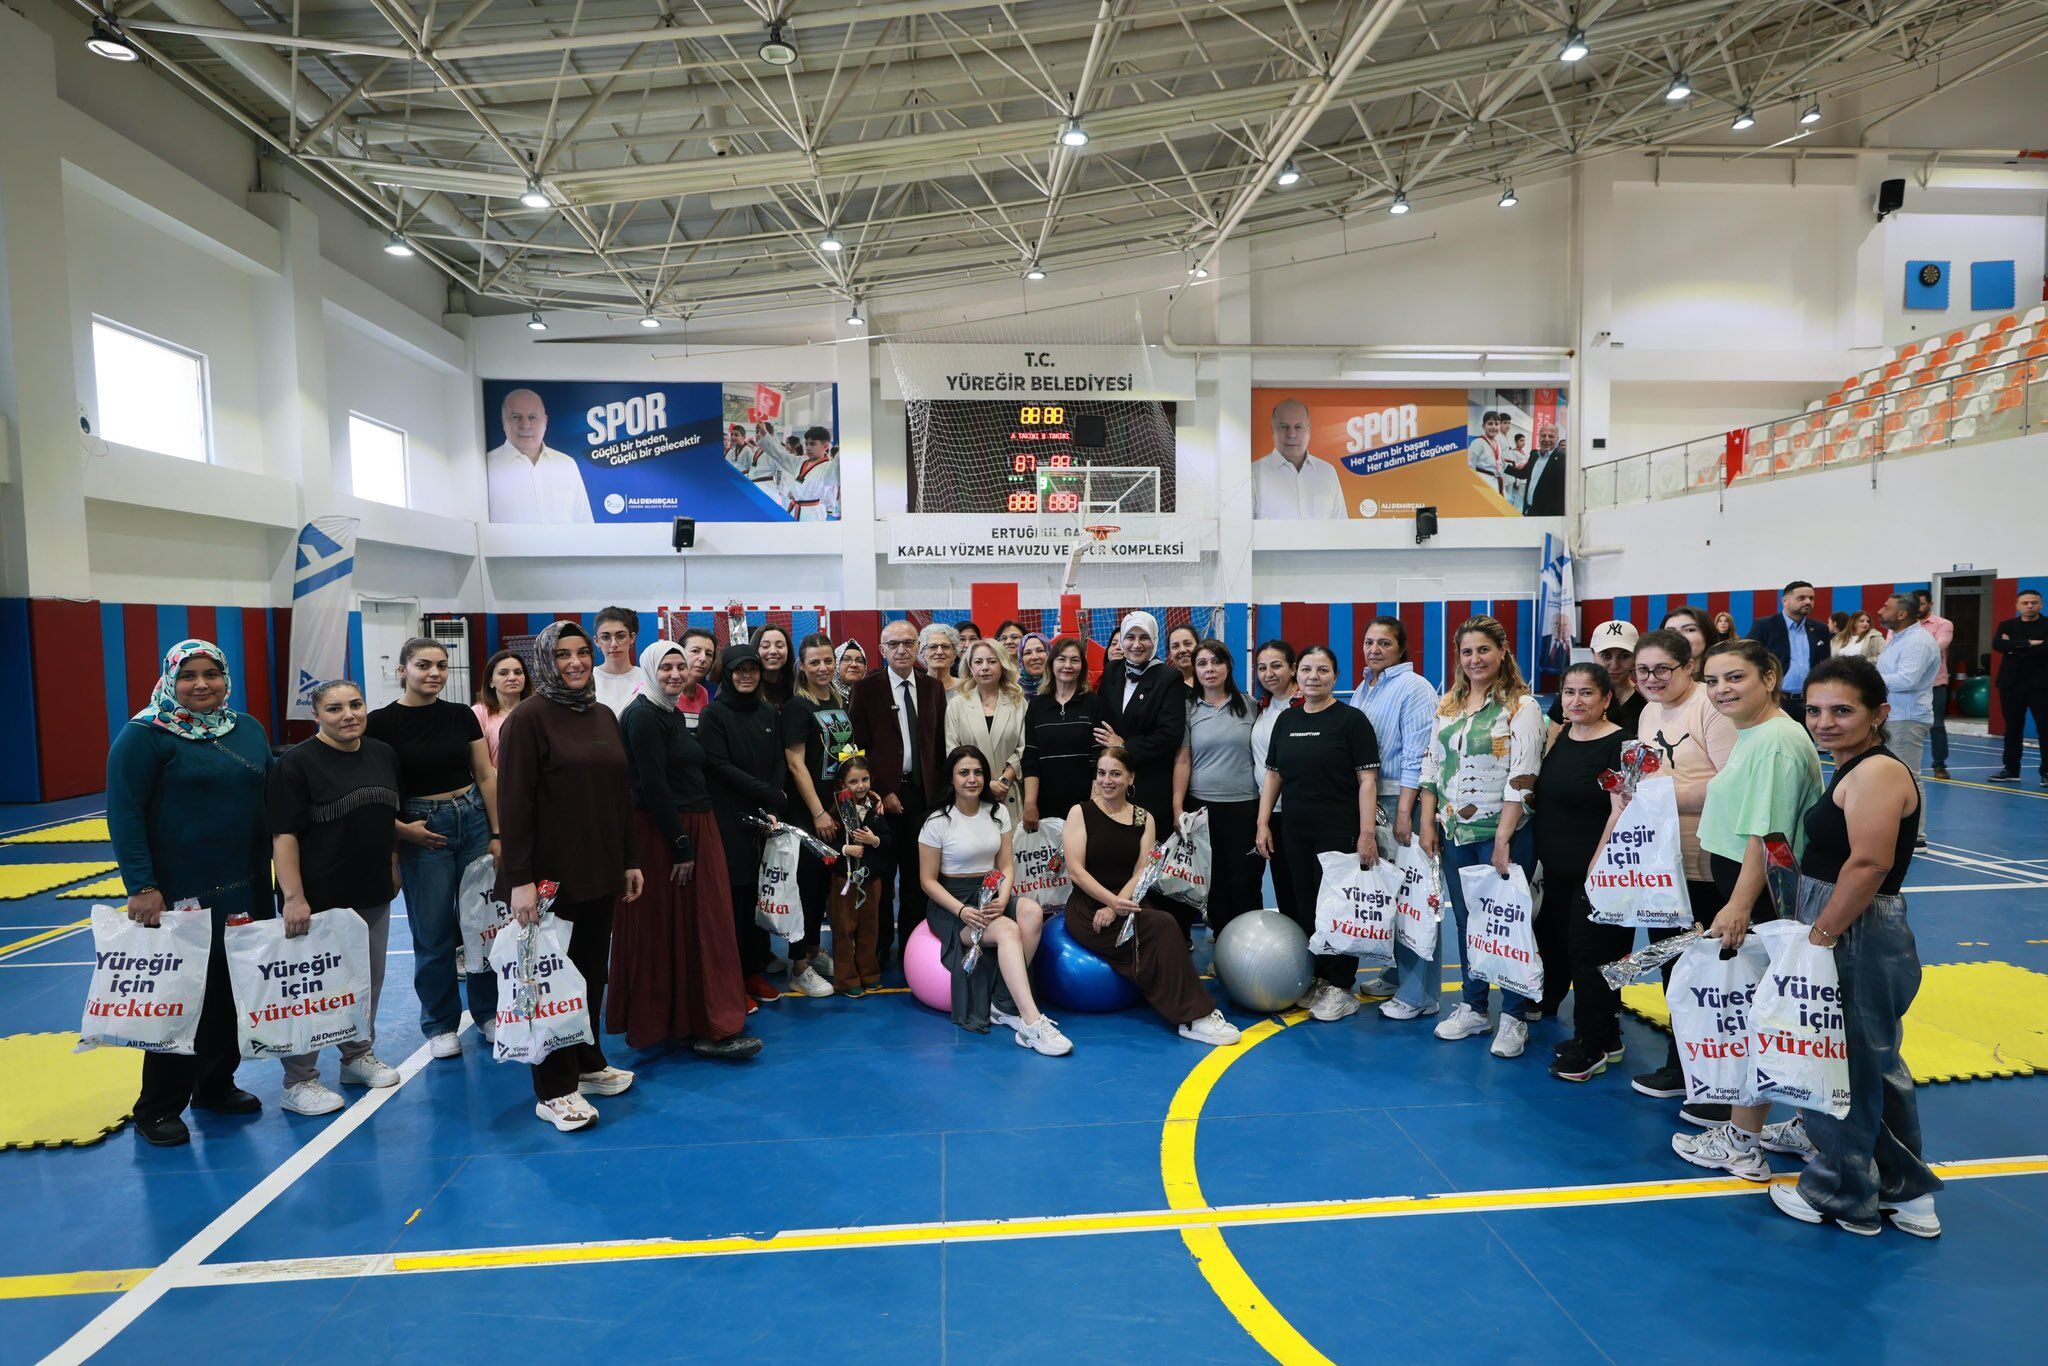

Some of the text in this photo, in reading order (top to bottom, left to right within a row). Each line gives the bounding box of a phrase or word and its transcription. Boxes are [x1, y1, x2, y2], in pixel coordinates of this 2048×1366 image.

[1024, 352, 1055, 367] T.C.
[946, 372, 1133, 391] YÜREĞİR BELEDİYESİ
[586, 391, 668, 446] SPOR
[1346, 403, 1418, 453] SPOR
[591, 434, 668, 459] Güçlü bir beden,
[609, 434, 701, 465] Güçlü bir gelecektir
[1350, 439, 1430, 467] Her adım bir başarı
[1367, 442, 1459, 473] Her adım bir özgüven.
[898, 545, 946, 557] KAPALI
[950, 542, 994, 557] YÜZME
[998, 544, 1049, 556] HAVUZU
[1052, 544, 1069, 556] VE
[1111, 541, 1184, 556] KOMPLEKSİ
[1607, 846, 1640, 869] için
[1354, 904, 1383, 923] için
[96, 951, 183, 976] Yüreğir
[257, 952, 342, 981] Yüreğir
[110, 974, 155, 997] için
[281, 976, 323, 1000] için
[248, 992, 356, 1028] yürekten
[1716, 1009, 1748, 1036] içi
[1800, 1003, 1843, 1033] için
[310, 1034, 322, 1043] Ali
[1715, 1087, 1740, 1095] Yüreğir
